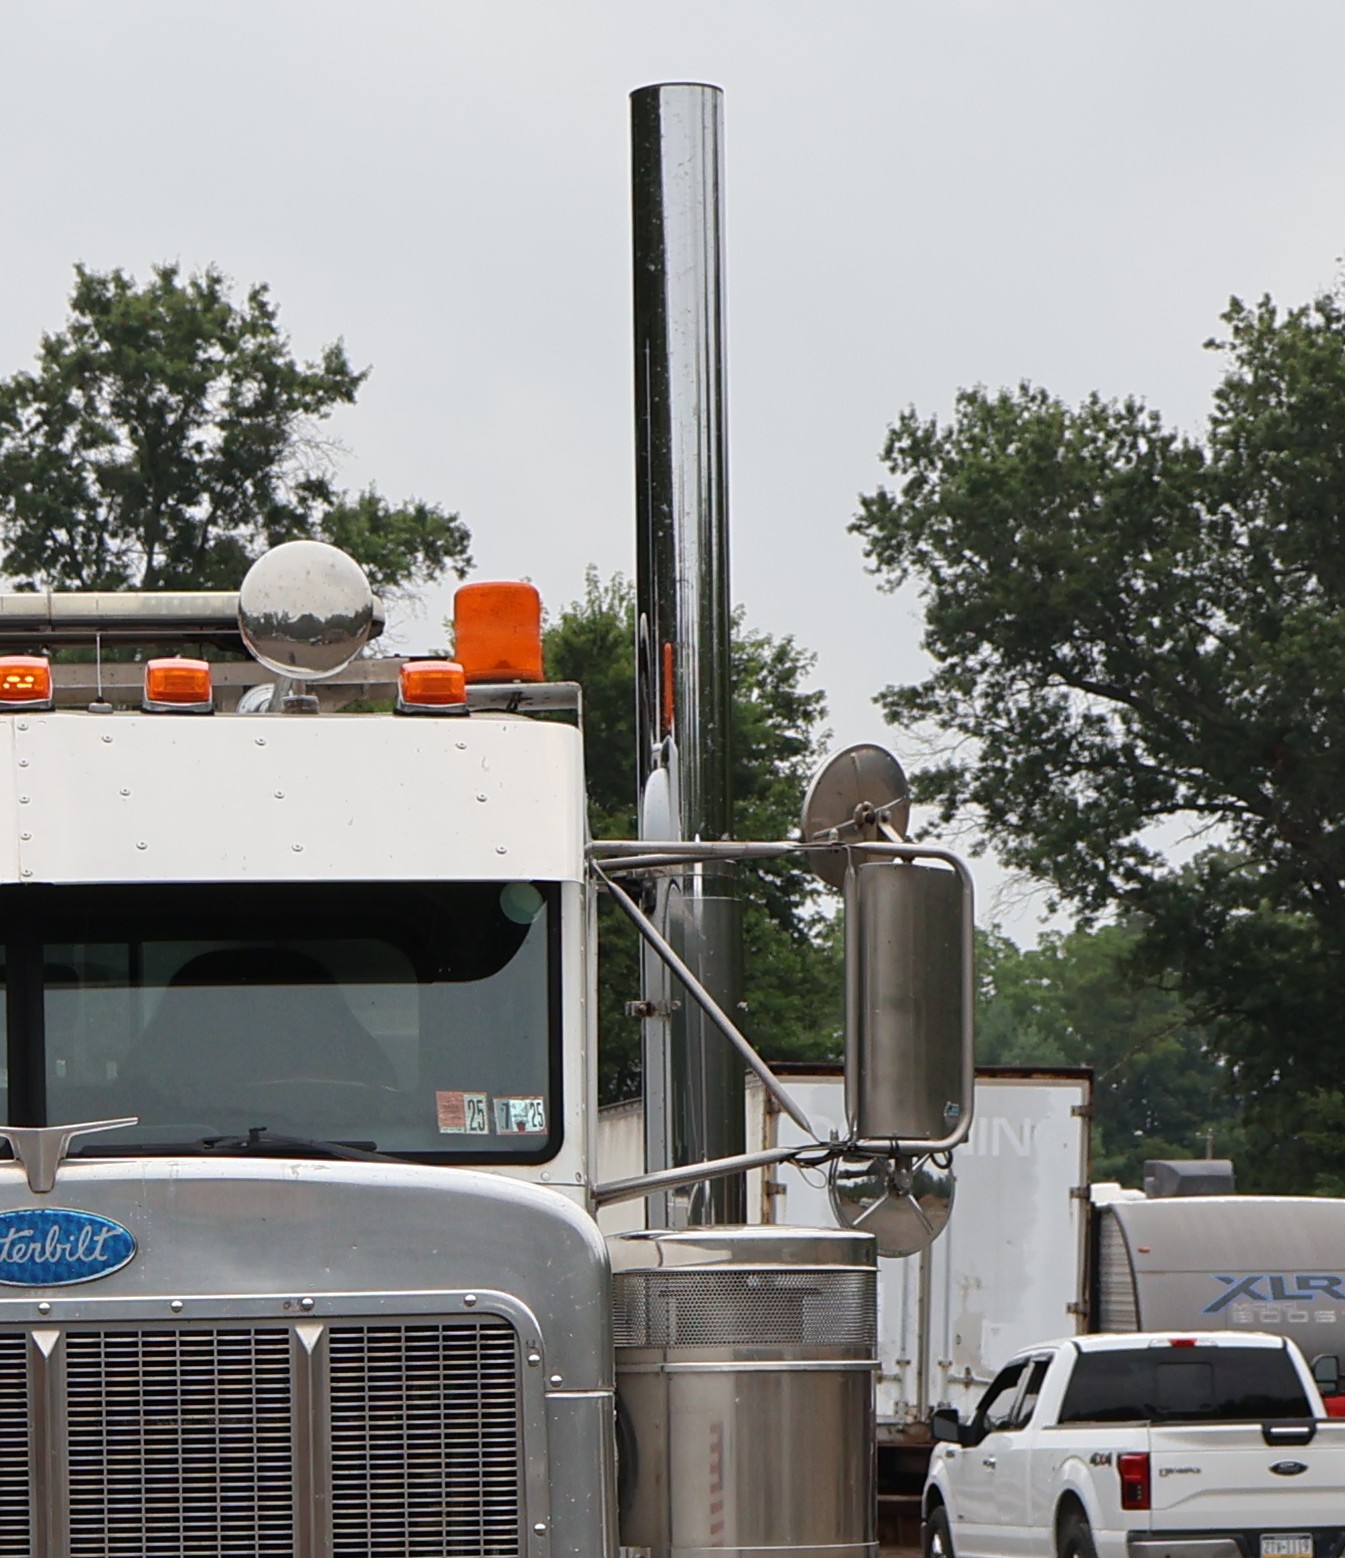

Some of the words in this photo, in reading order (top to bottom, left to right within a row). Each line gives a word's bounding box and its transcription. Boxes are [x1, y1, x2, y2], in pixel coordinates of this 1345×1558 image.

[467, 1098, 486, 1132] 25
[529, 1101, 544, 1128] 25
[1201, 1274, 1345, 1315] XLR
